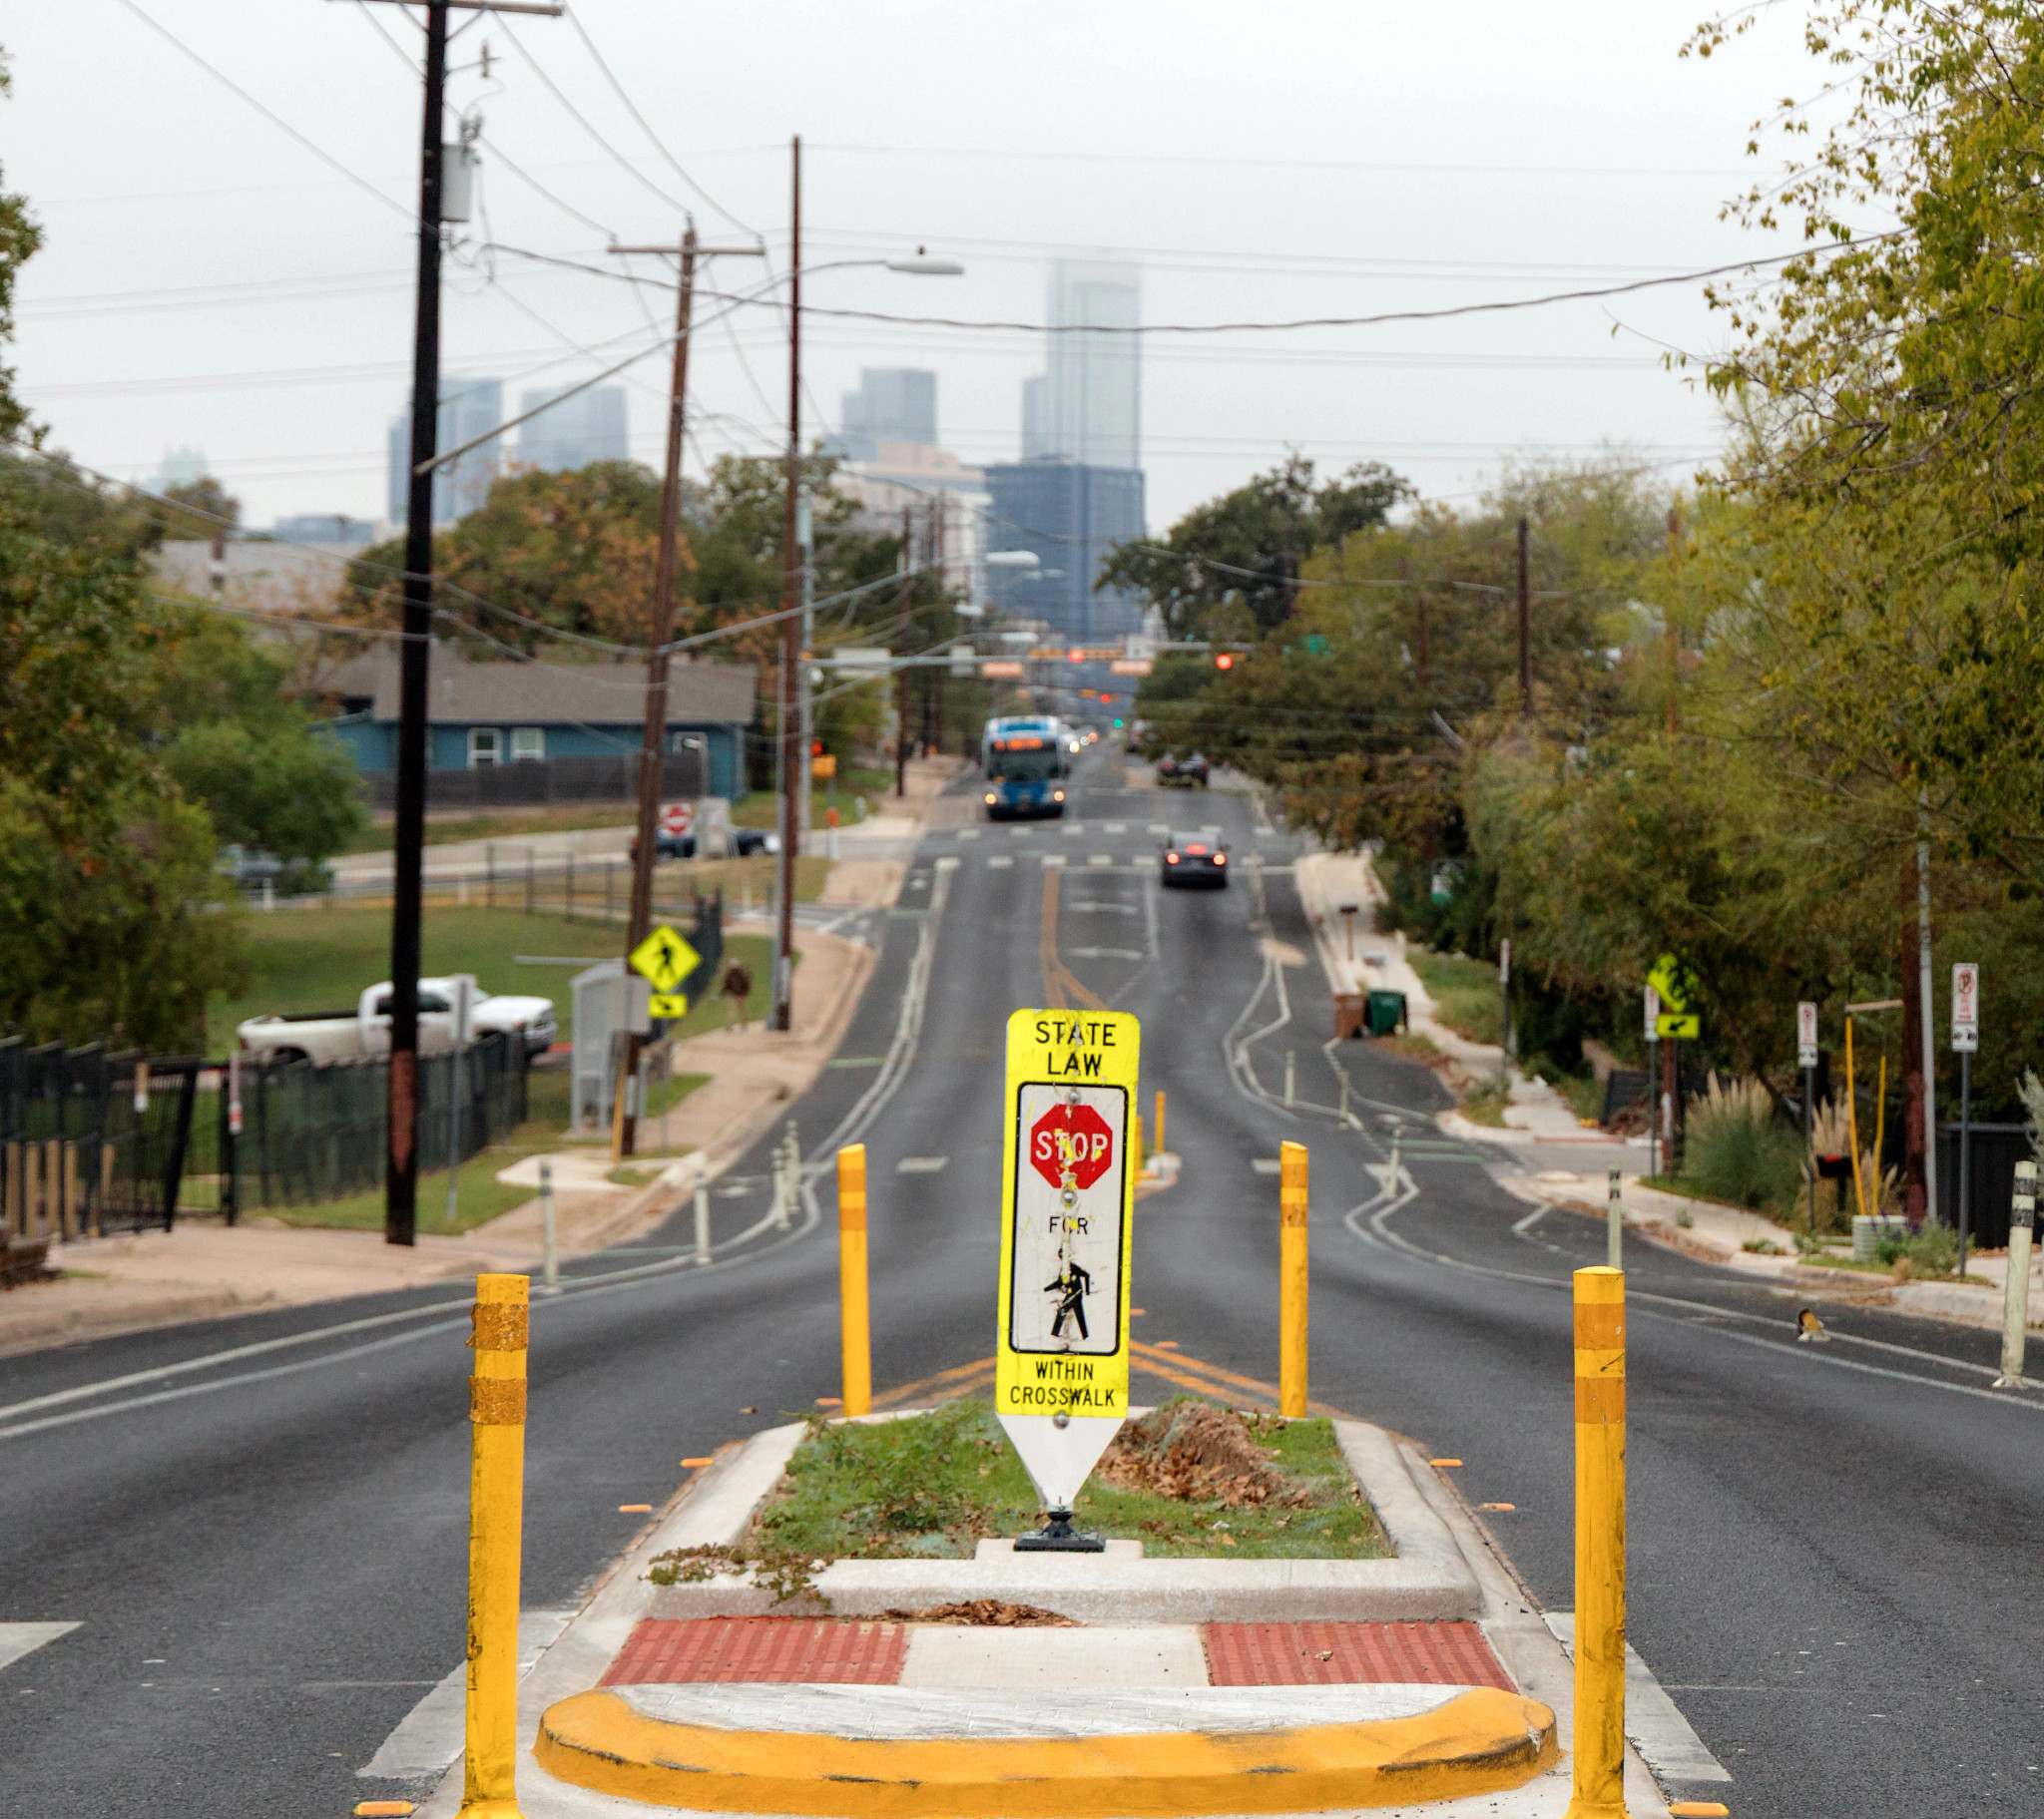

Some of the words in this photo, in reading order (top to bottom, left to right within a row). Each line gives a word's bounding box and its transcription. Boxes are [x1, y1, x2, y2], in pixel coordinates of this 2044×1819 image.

[1035, 1021, 1116, 1047] STATE
[1048, 1052, 1102, 1077] LAW
[1035, 1131, 1108, 1161] STOP
[1036, 1360, 1094, 1380] WITHIN
[1010, 1386, 1115, 1406] CROSSWALK
